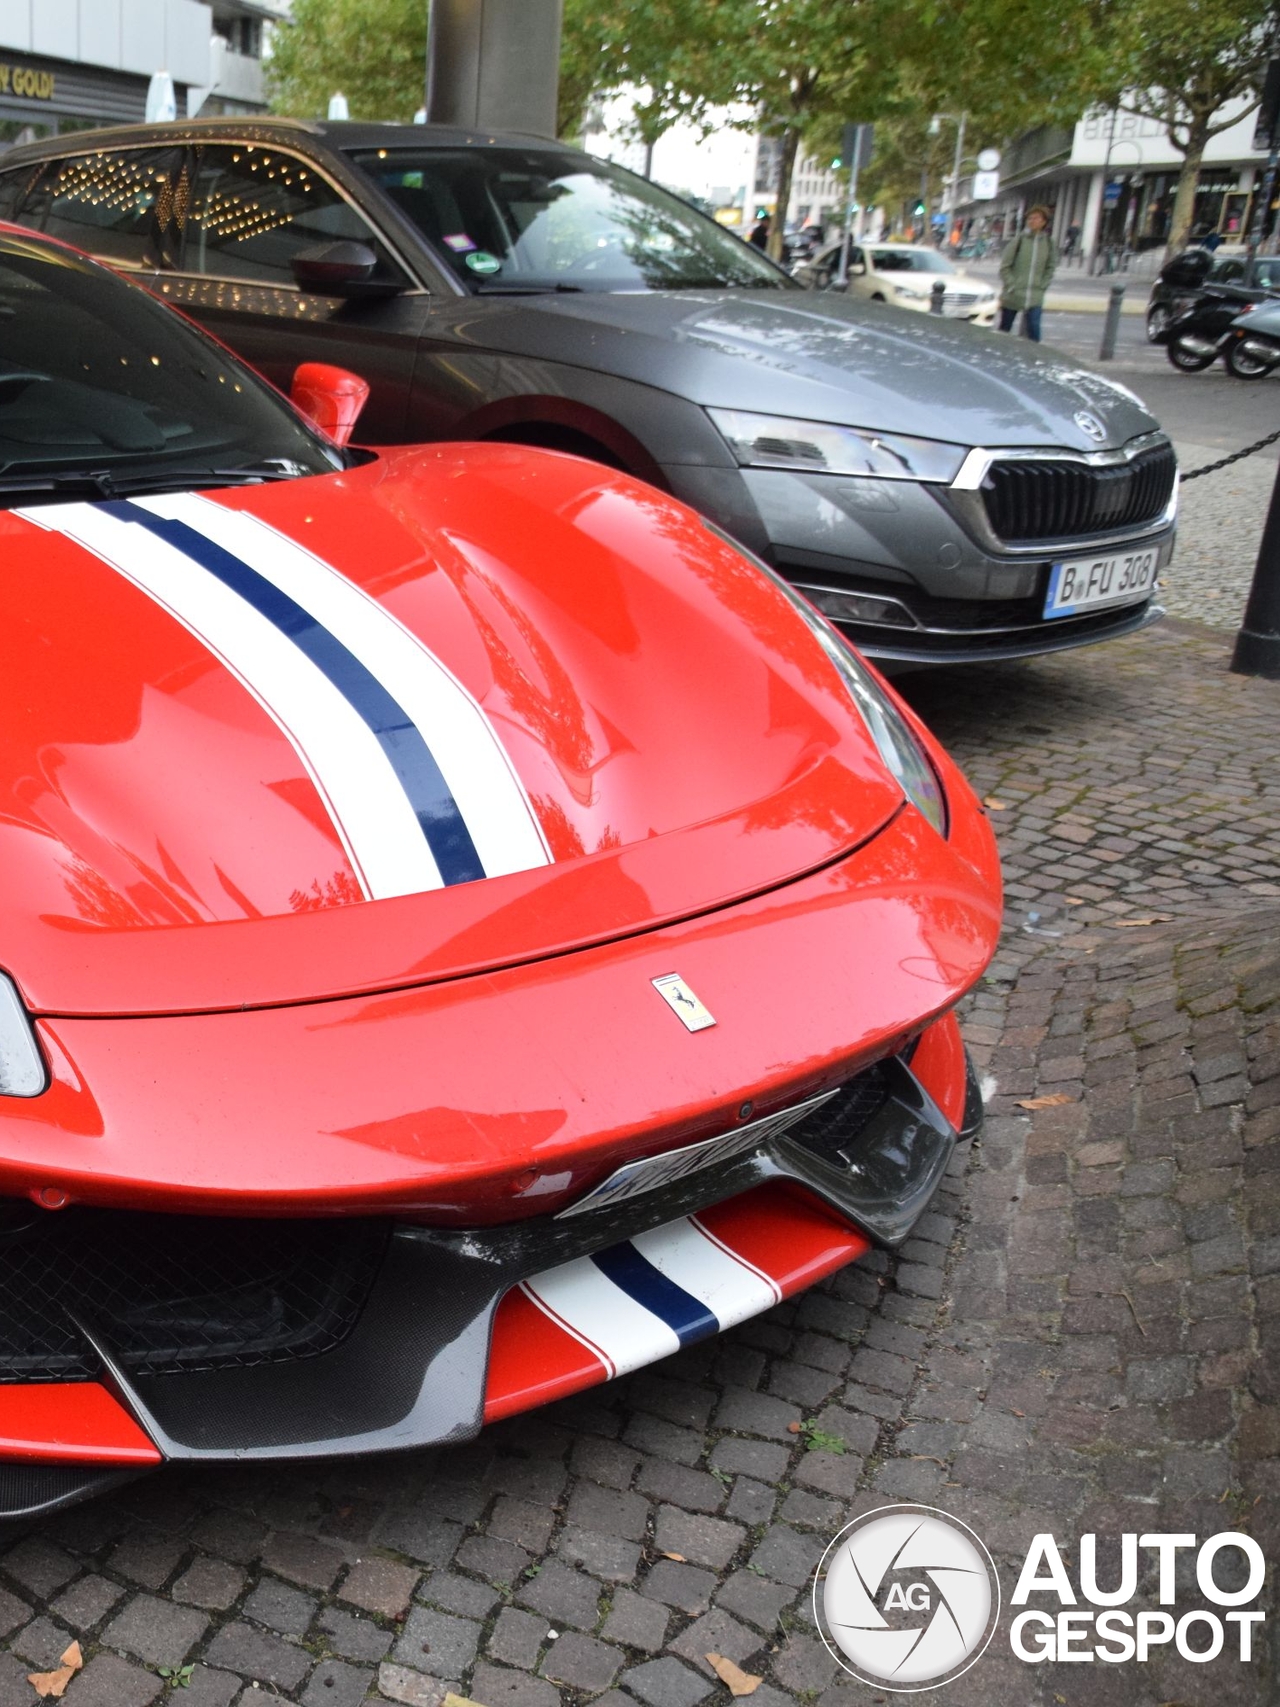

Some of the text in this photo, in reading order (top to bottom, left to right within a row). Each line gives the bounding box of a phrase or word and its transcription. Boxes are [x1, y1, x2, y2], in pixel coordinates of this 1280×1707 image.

[1060, 553, 1152, 603] B FU 308
